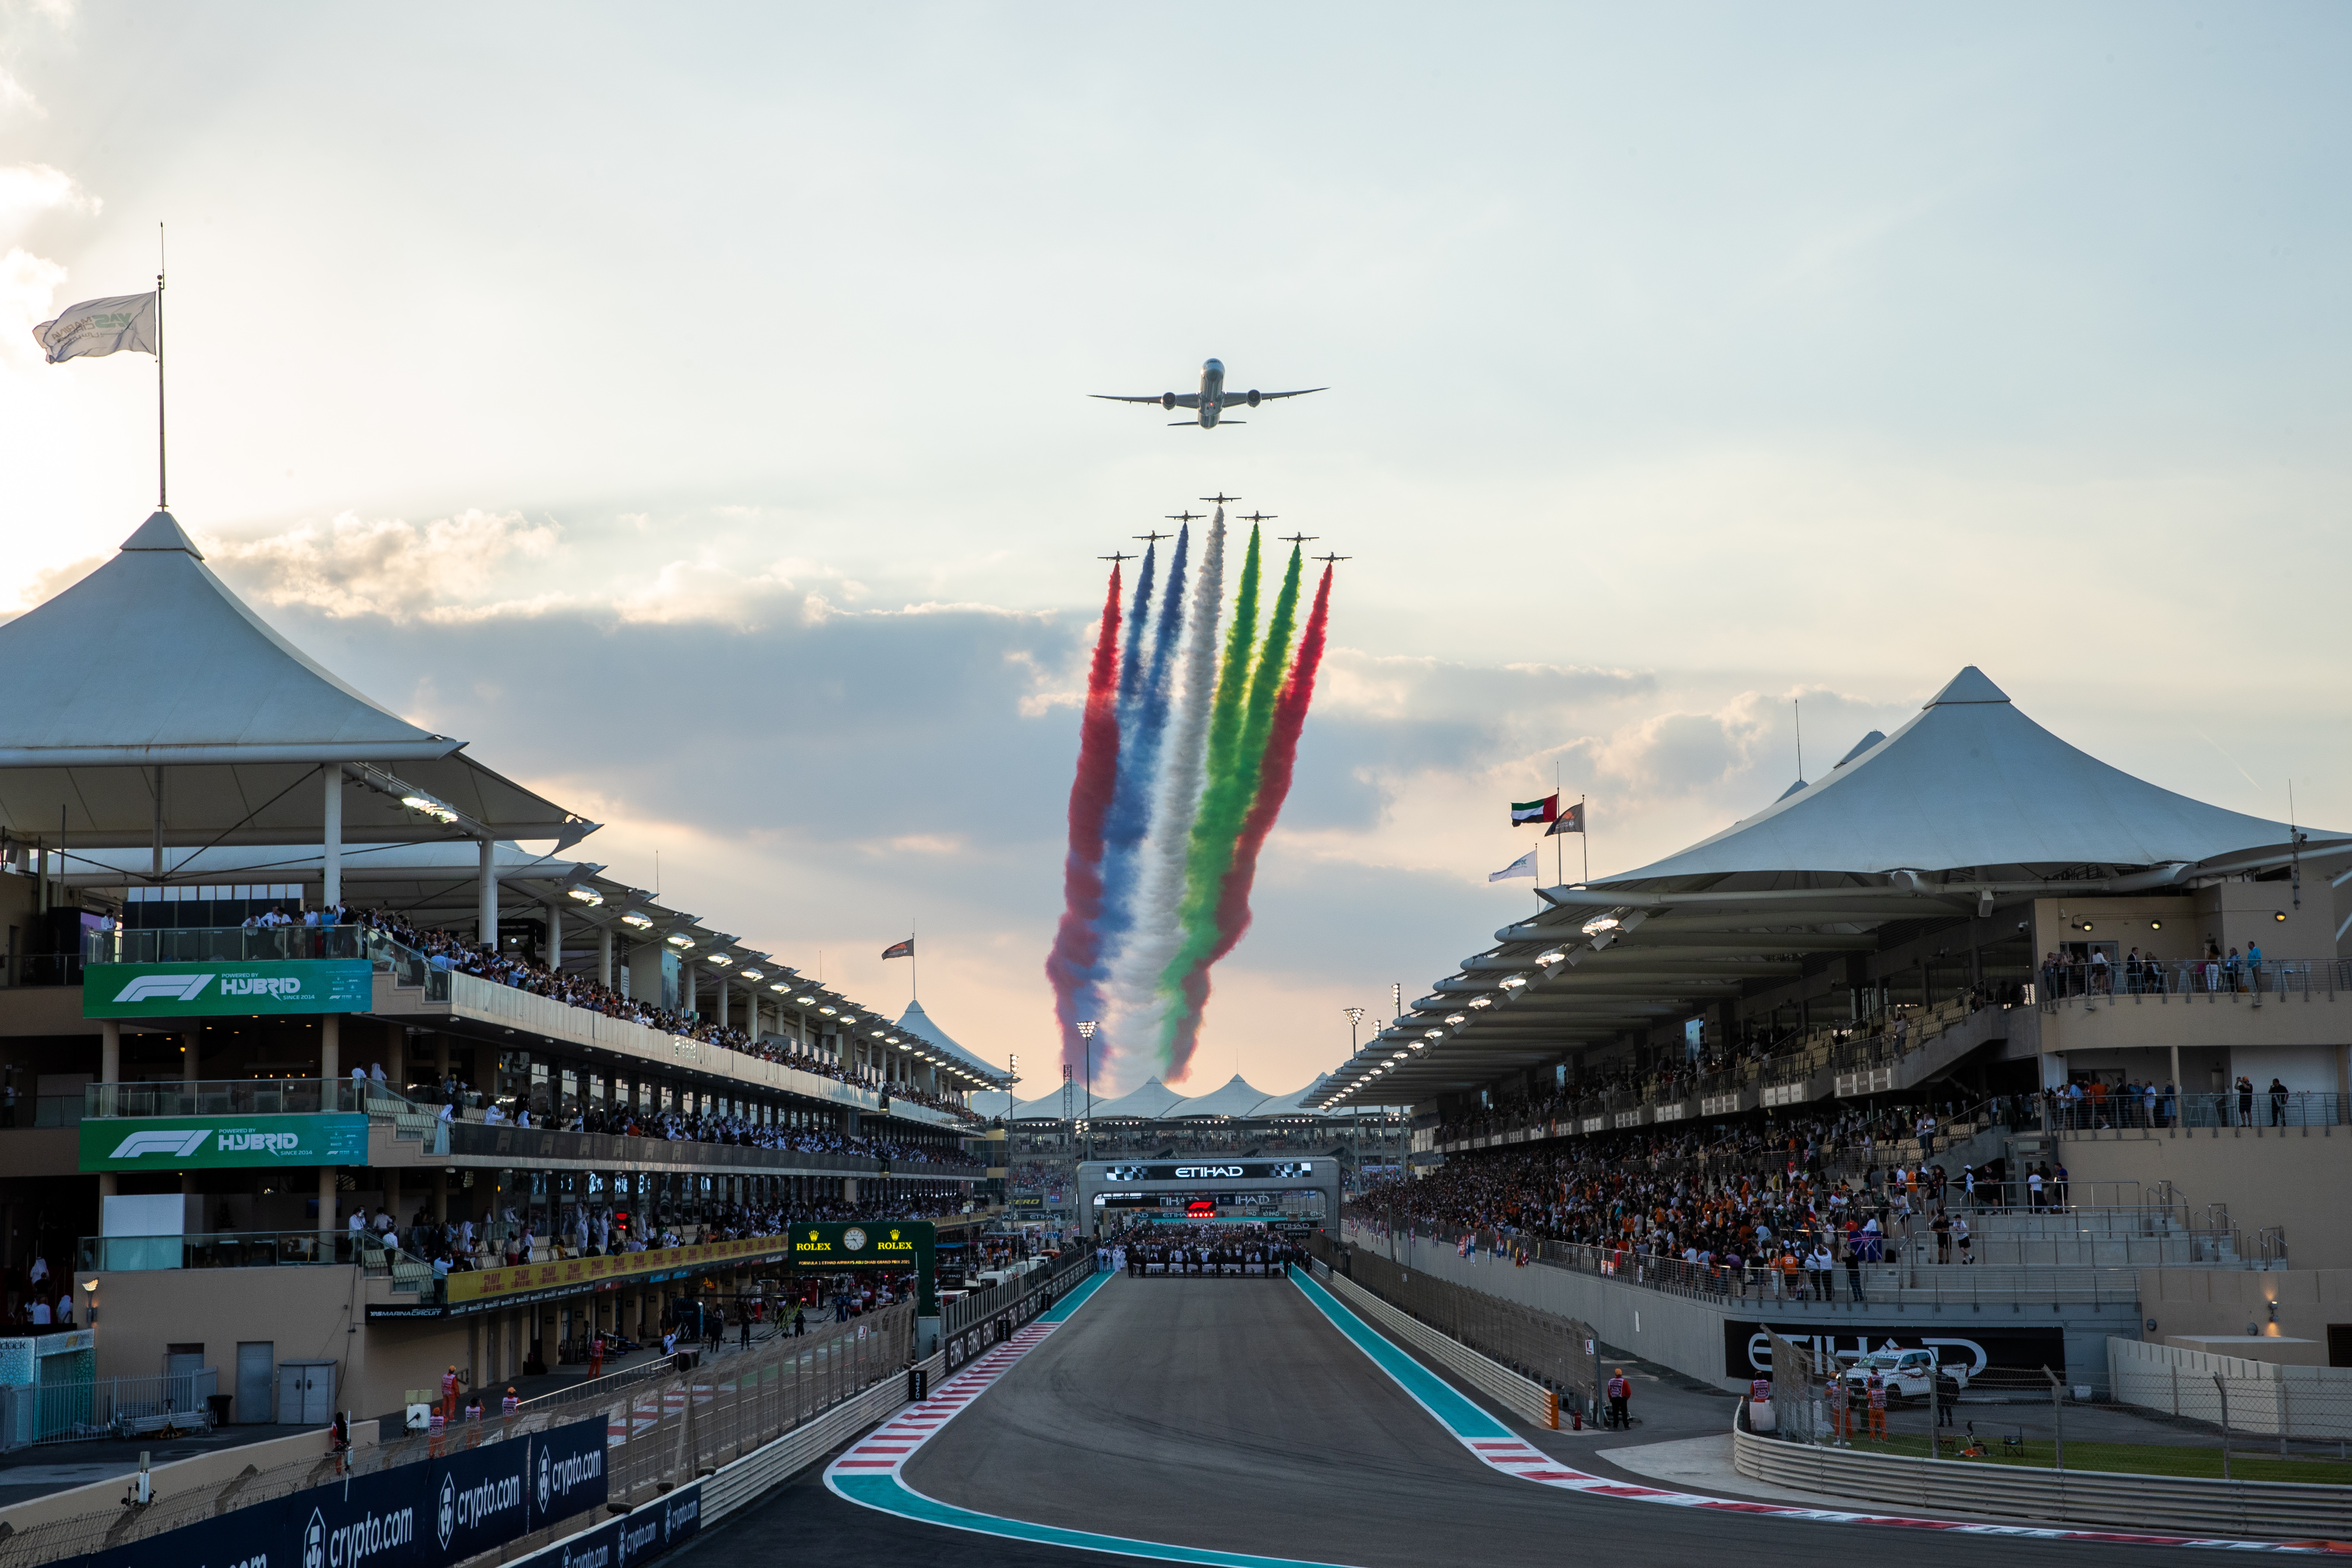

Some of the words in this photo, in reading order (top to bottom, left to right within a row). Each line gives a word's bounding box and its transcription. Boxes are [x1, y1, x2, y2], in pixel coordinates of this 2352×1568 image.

[221, 978, 301, 1001] HYBRID
[218, 1133, 298, 1157] HYBRID
[1175, 1166, 1244, 1178] ETIHAD
[951, 1337, 964, 1367] ETIHAD
[968, 1328, 980, 1356] ETIHAD
[552, 1449, 601, 1496] crypto.com
[457, 1474, 519, 1529] crypto.com
[672, 1500, 697, 1531] crypto.com
[330, 1505, 412, 1568] crypto.com
[627, 1521, 656, 1555] crypto.com
